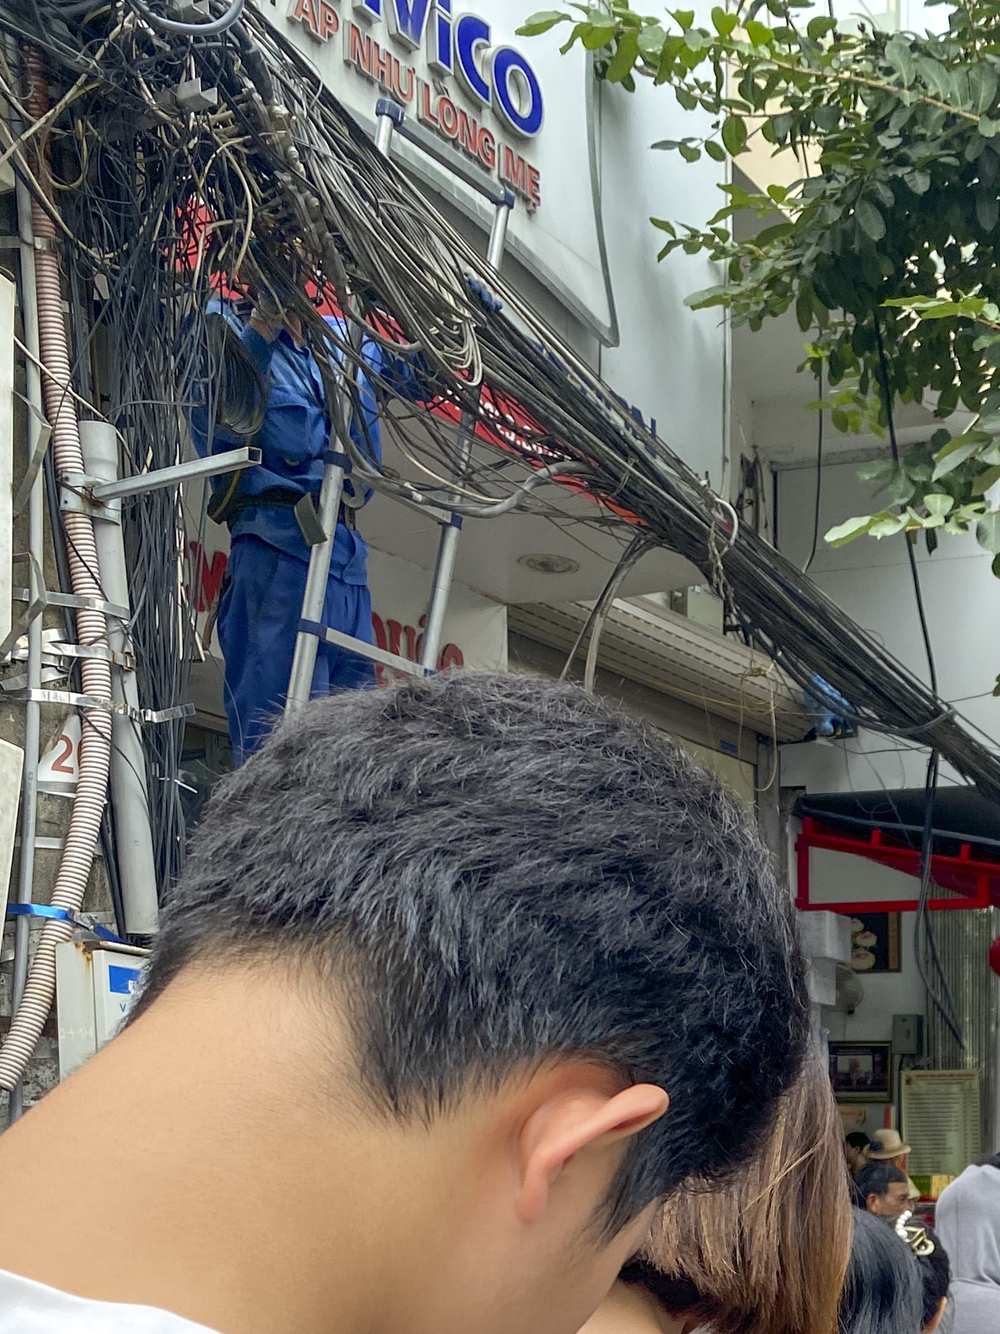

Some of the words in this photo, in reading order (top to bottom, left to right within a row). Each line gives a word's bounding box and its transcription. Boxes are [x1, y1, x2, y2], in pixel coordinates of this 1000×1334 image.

[348, 20, 417, 105] NHƯ
[419, 79, 496, 170] LÒNG
[503, 143, 541, 208] MẸ
